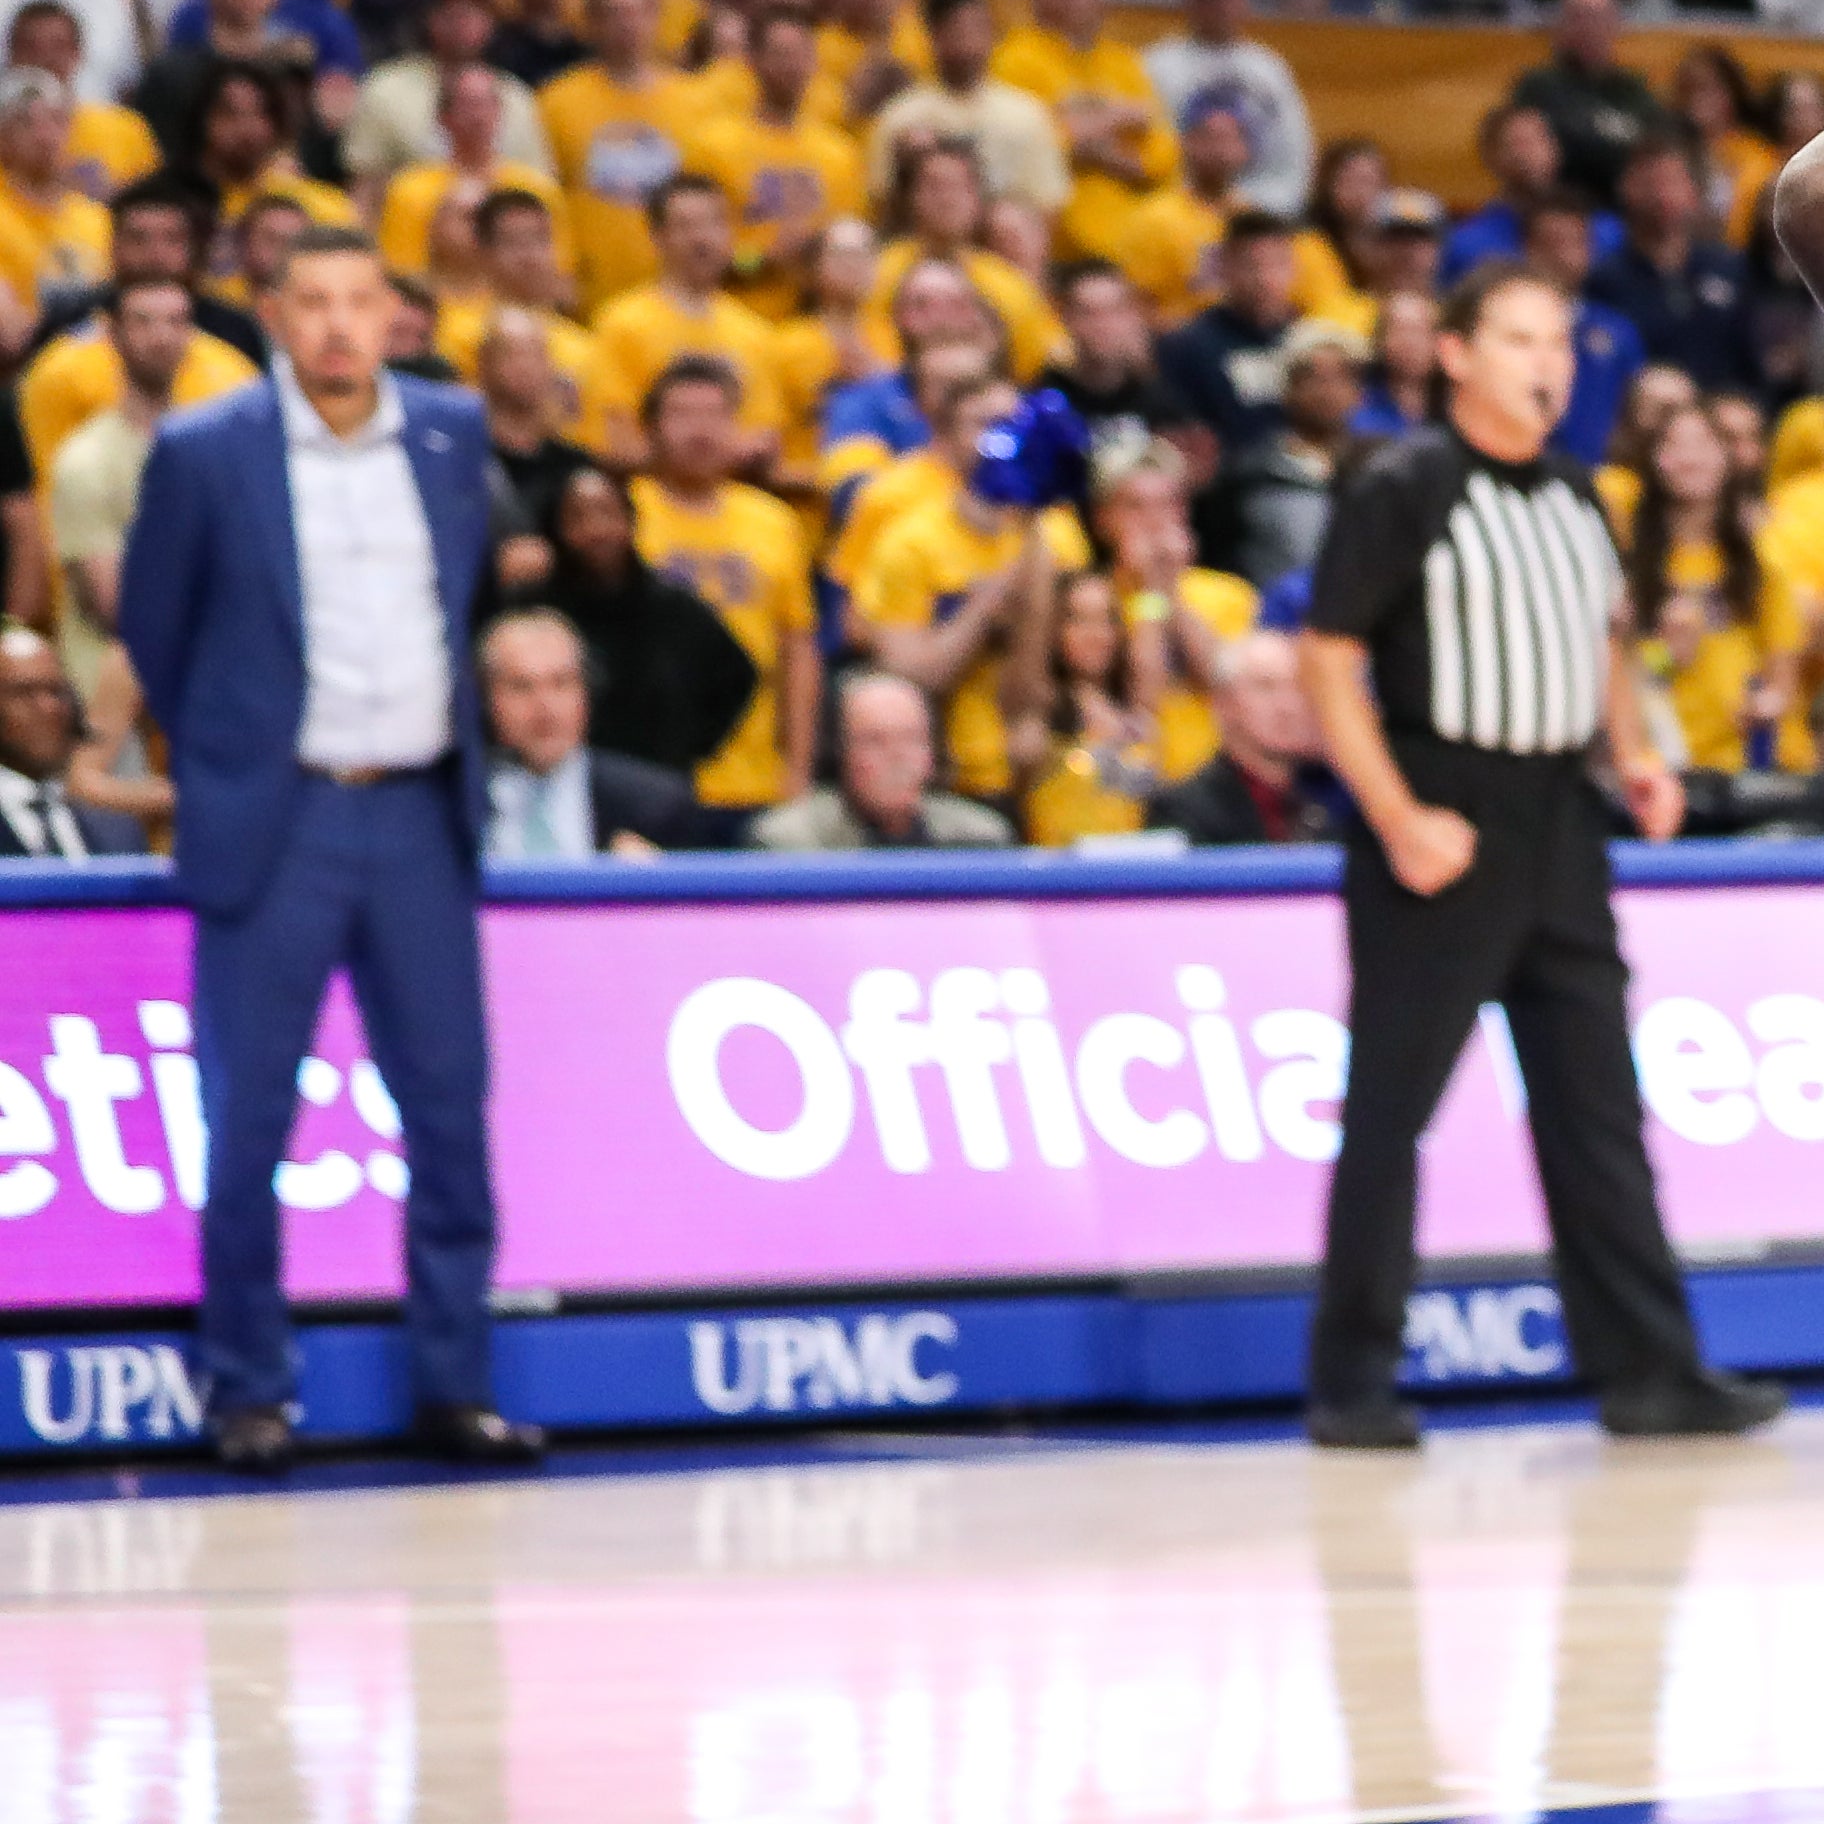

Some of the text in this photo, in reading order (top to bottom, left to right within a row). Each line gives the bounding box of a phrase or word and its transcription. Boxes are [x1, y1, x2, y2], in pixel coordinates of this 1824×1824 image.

[664, 964, 1352, 1181] Officia
[690, 1310, 960, 1422] UPMC
[1402, 1284, 1564, 1379] MC
[17, 1344, 212, 1444] UPM
